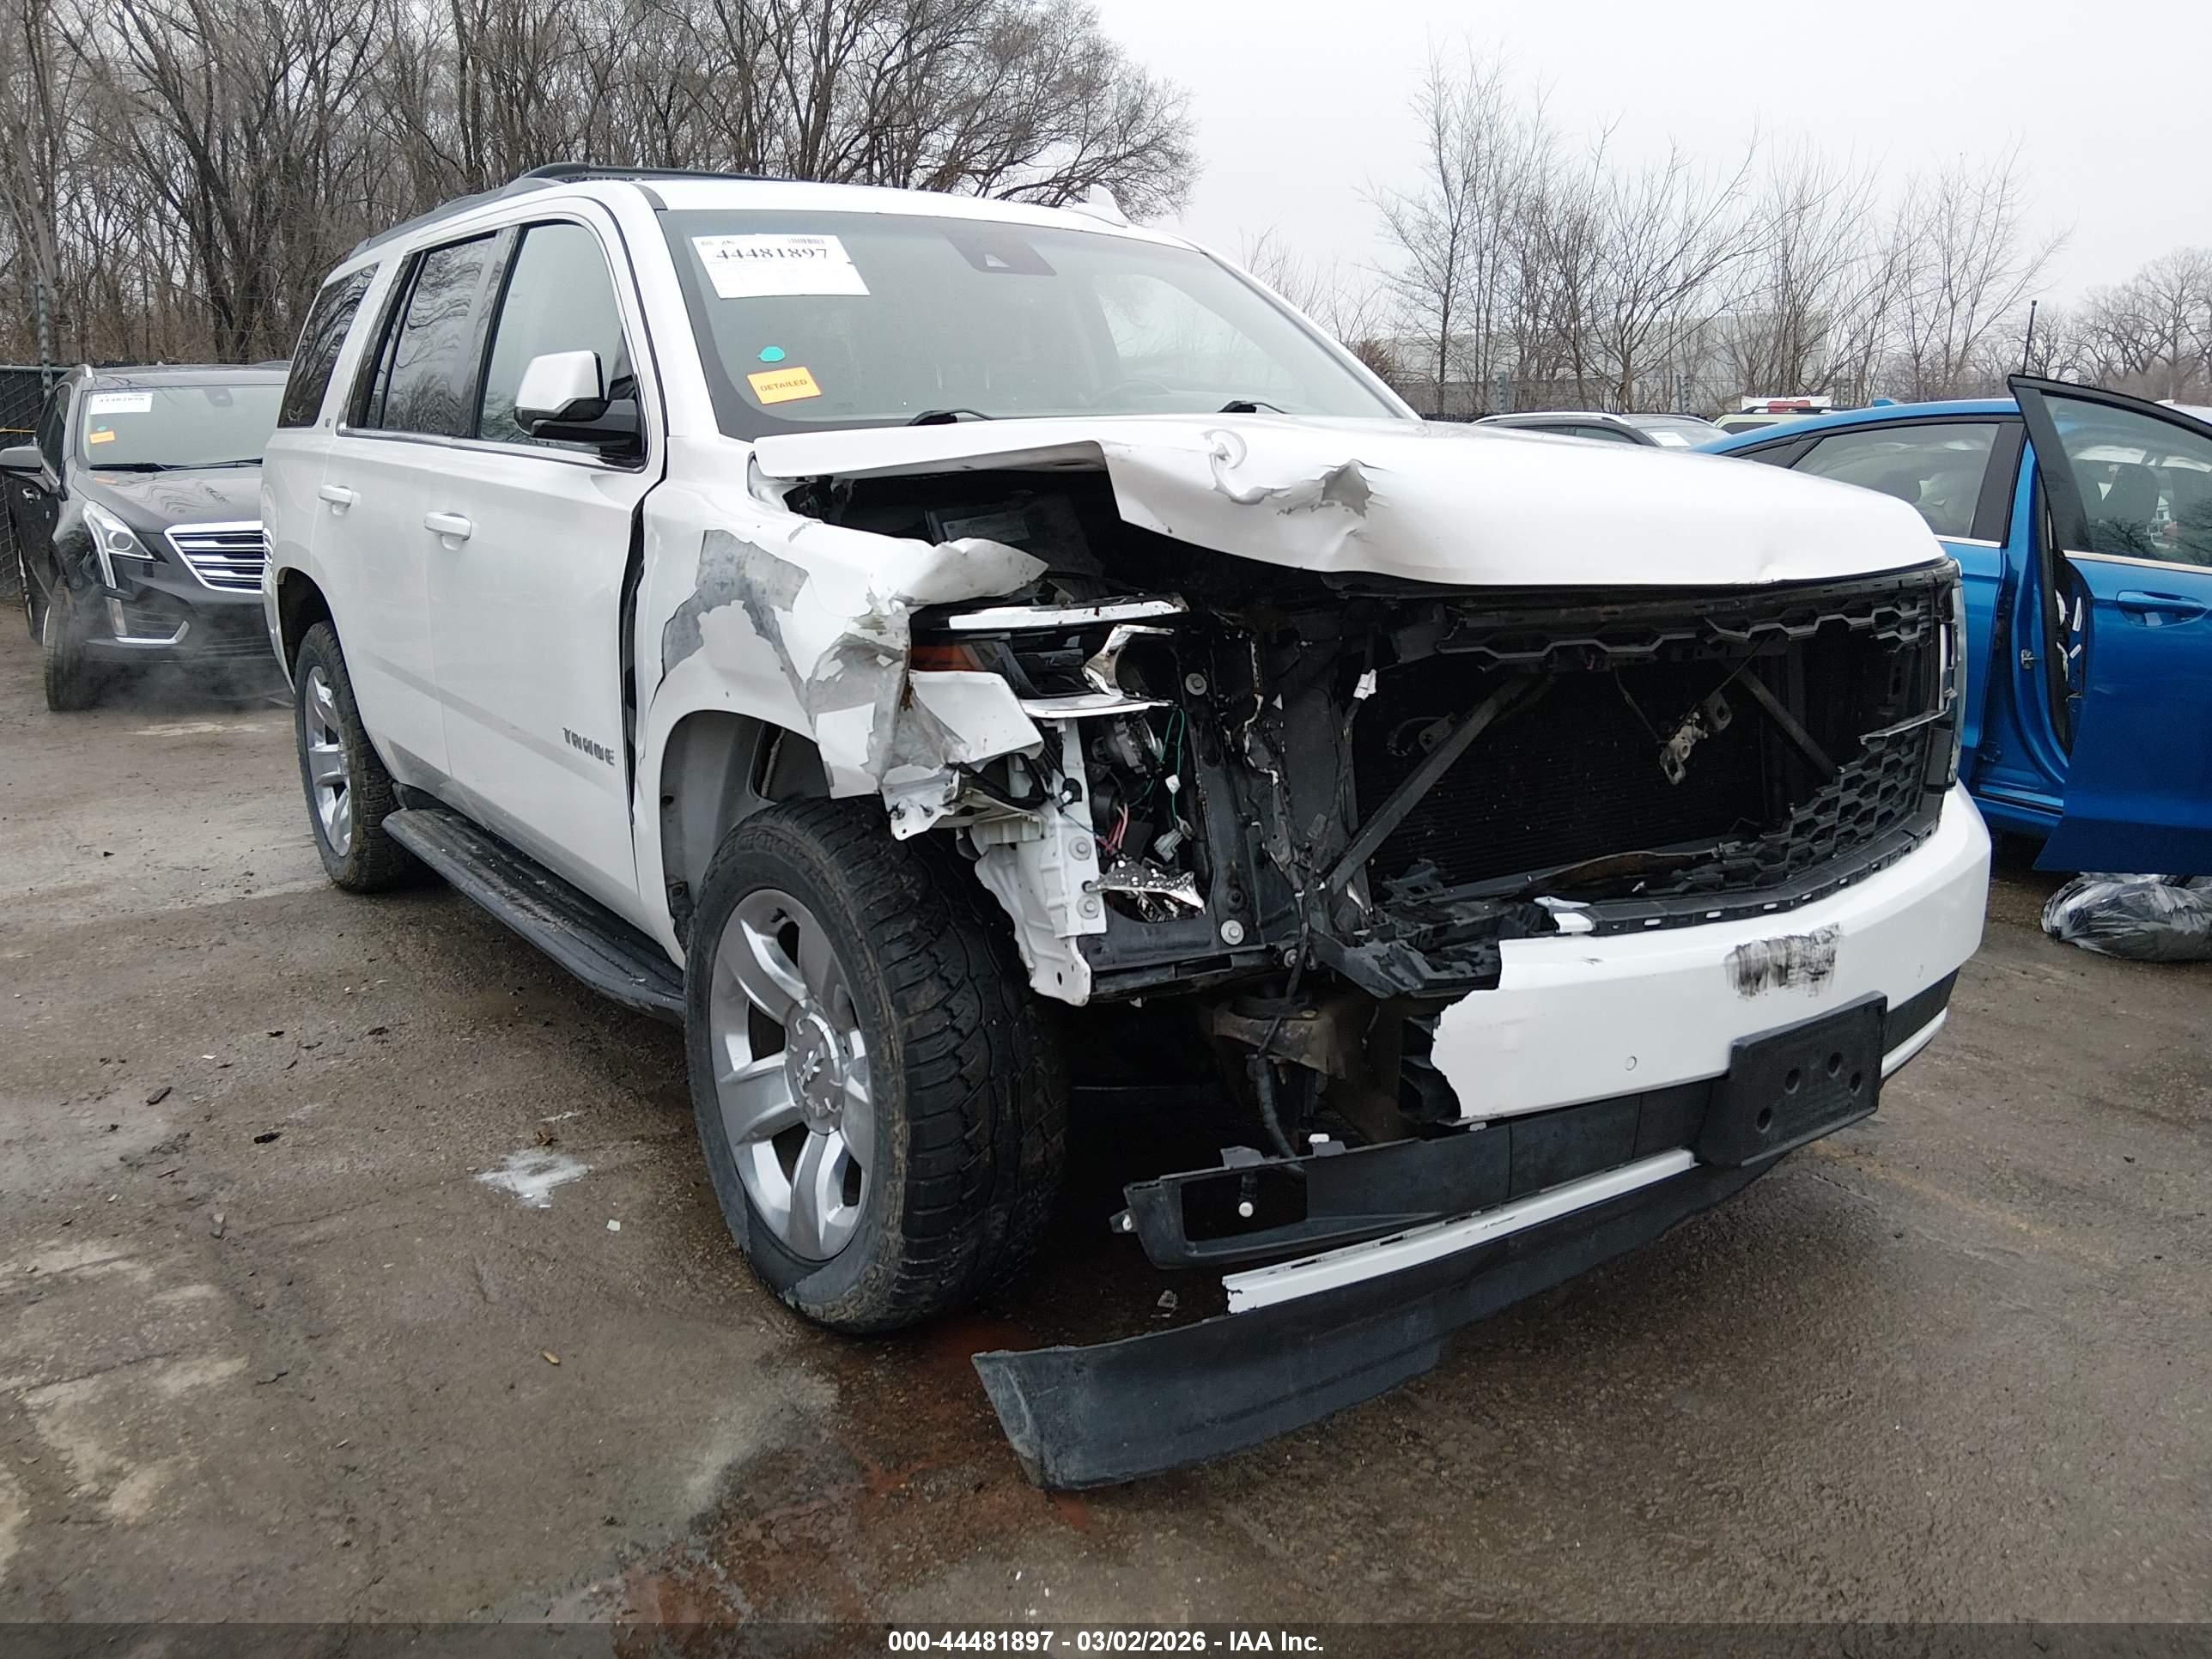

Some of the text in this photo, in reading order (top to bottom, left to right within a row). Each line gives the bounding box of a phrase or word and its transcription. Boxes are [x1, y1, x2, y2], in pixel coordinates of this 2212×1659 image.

[716, 247, 827, 260] 44481897
[759, 379, 808, 392] DETAILED
[562, 727, 616, 768] TAHOE
